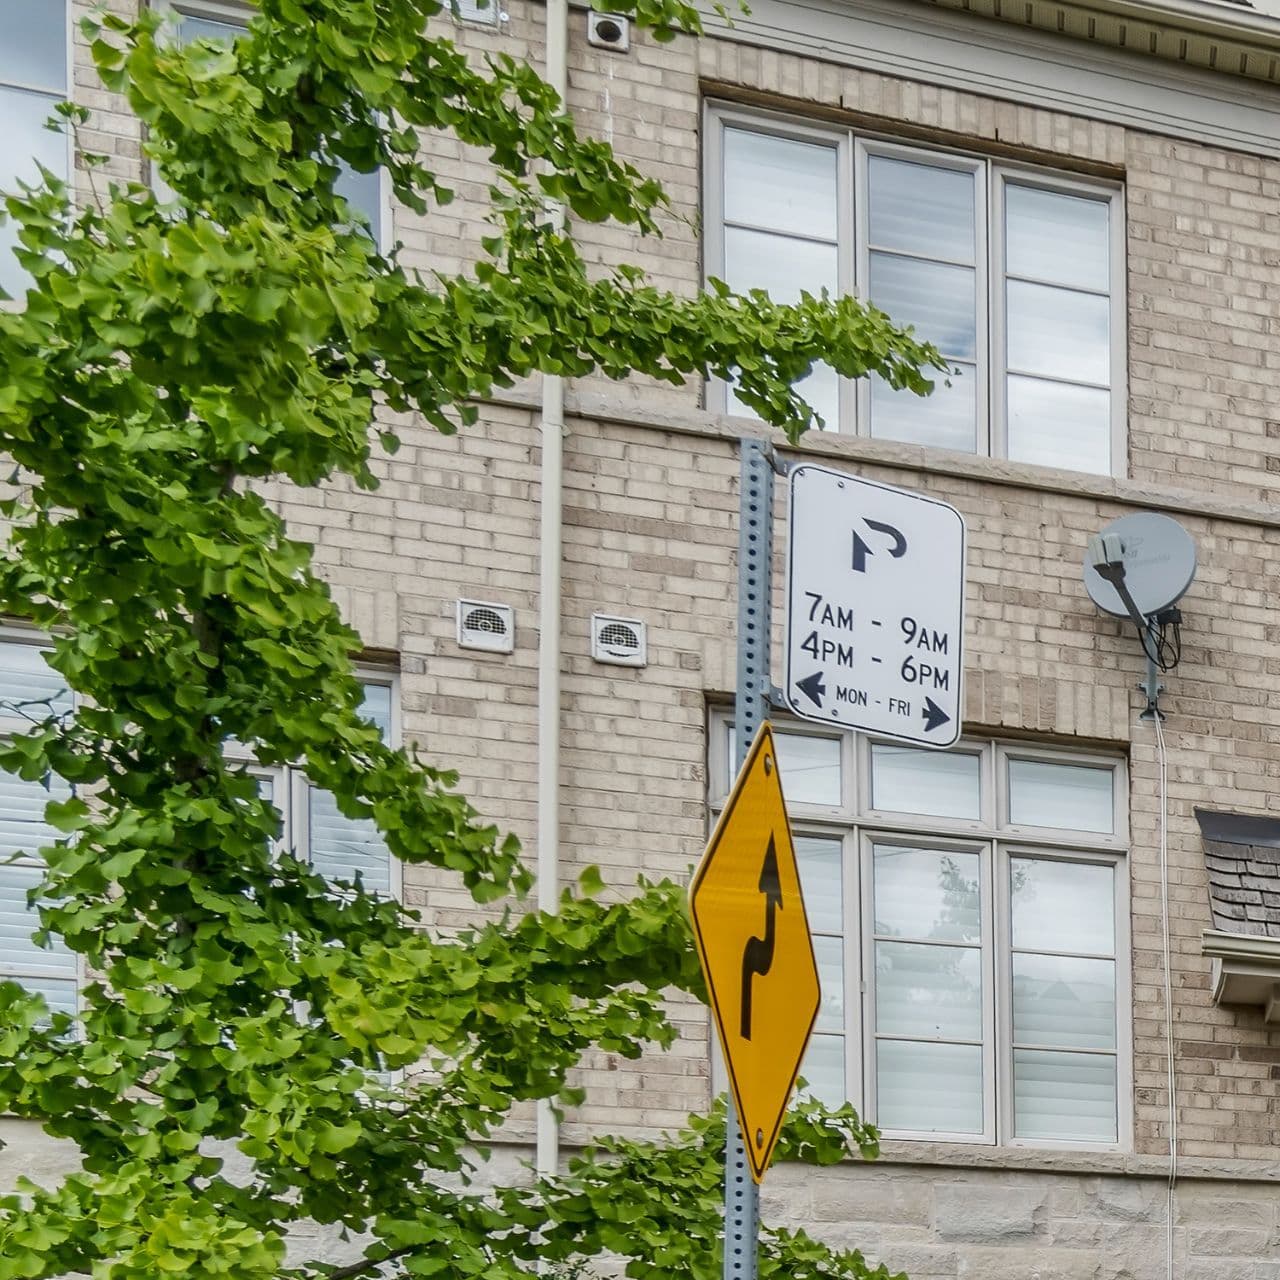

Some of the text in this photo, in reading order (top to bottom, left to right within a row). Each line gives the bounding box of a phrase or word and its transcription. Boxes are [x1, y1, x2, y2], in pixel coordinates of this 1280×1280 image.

[805, 591, 853, 631] 7AM
[900, 617, 948, 655] 9AM
[801, 631, 853, 668] 4PM
[901, 655, 949, 691] 6PM
[836, 685, 867, 706] MON
[889, 698, 911, 716] FRI
